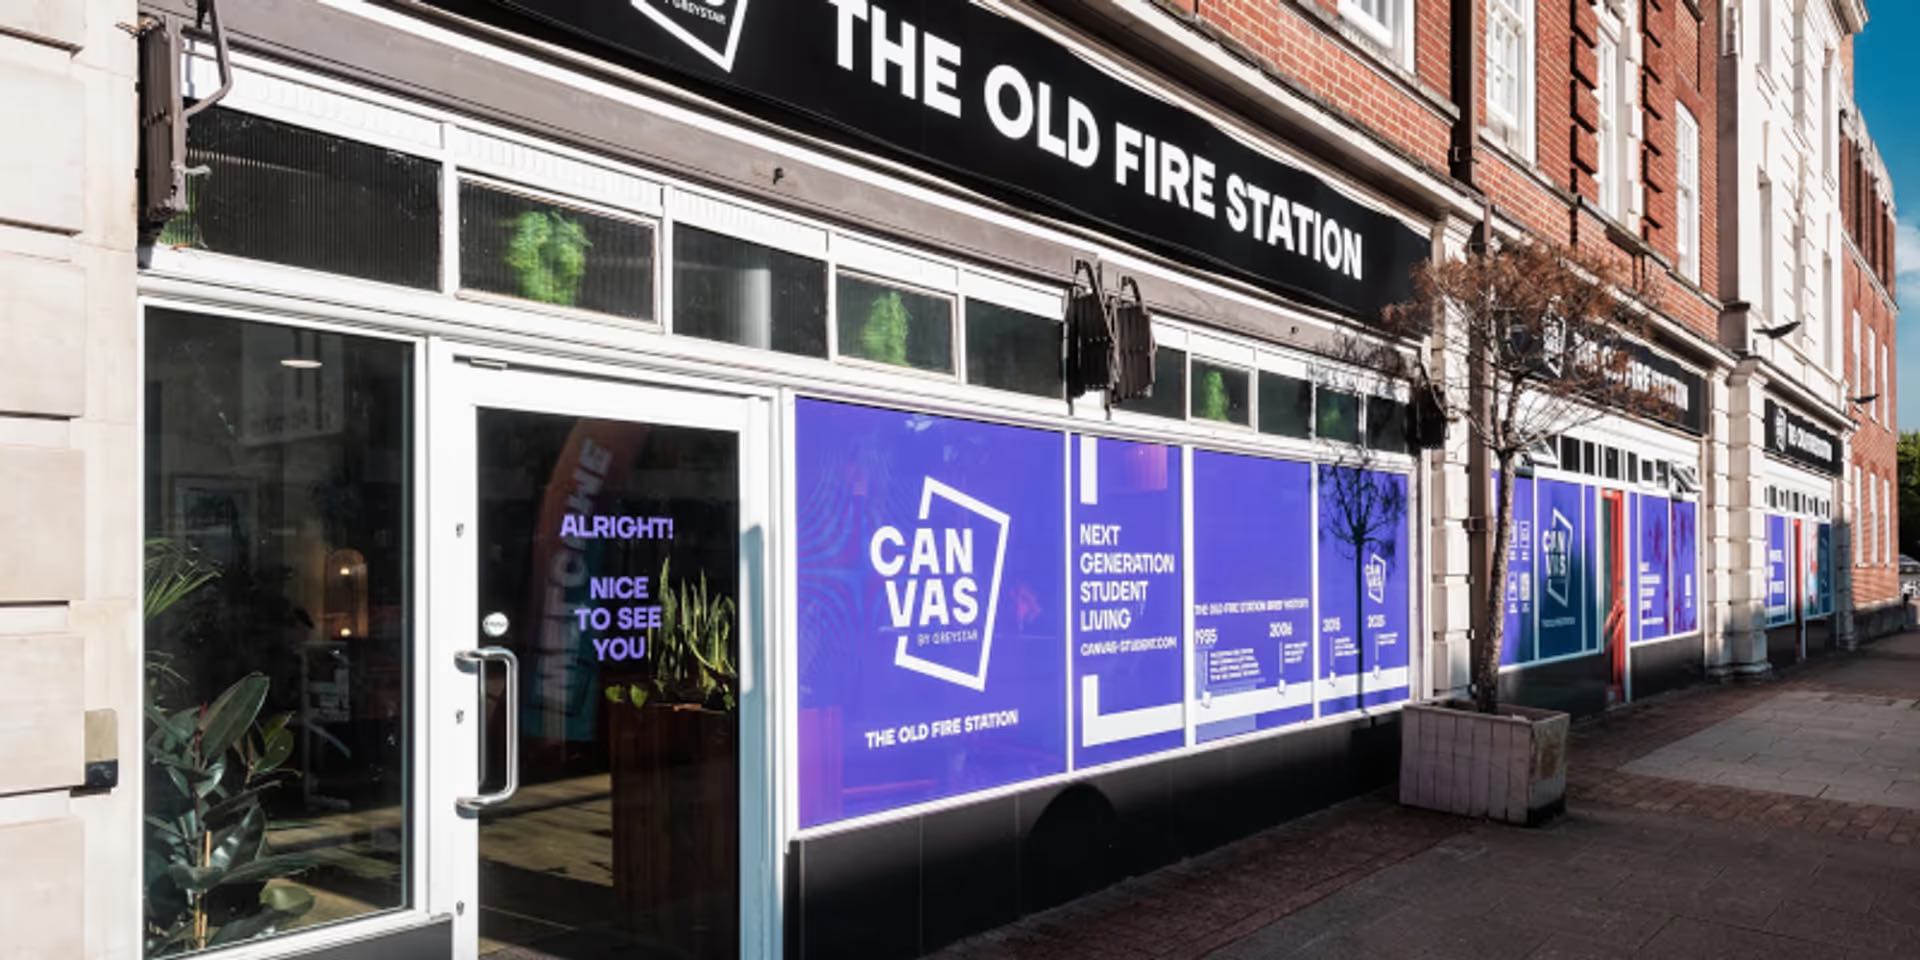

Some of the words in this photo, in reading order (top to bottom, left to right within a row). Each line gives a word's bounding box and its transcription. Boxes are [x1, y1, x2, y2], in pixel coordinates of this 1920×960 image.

[828, 0, 961, 118] THE
[984, 64, 1100, 168] OLD
[1115, 121, 1216, 219] FIRE
[1225, 173, 1362, 280] STATION
[560, 514, 674, 539] ALRIGHT!
[1080, 523, 1121, 546] NEXT
[870, 525, 974, 577] CAN
[1080, 552, 1175, 574] GENERATION
[590, 576, 649, 599] NICE
[1080, 580, 1149, 603] STUDENT
[885, 576, 979, 628] VAS
[574, 607, 611, 630] TO
[617, 606, 662, 629] SEE
[1080, 607, 1132, 632] LIVING
[593, 637, 646, 661] YOU
[865, 729, 896, 749] THE
[898, 723, 929, 744] OLD
[931, 718, 962, 738] FIRE
[964, 709, 1019, 733] STATION
